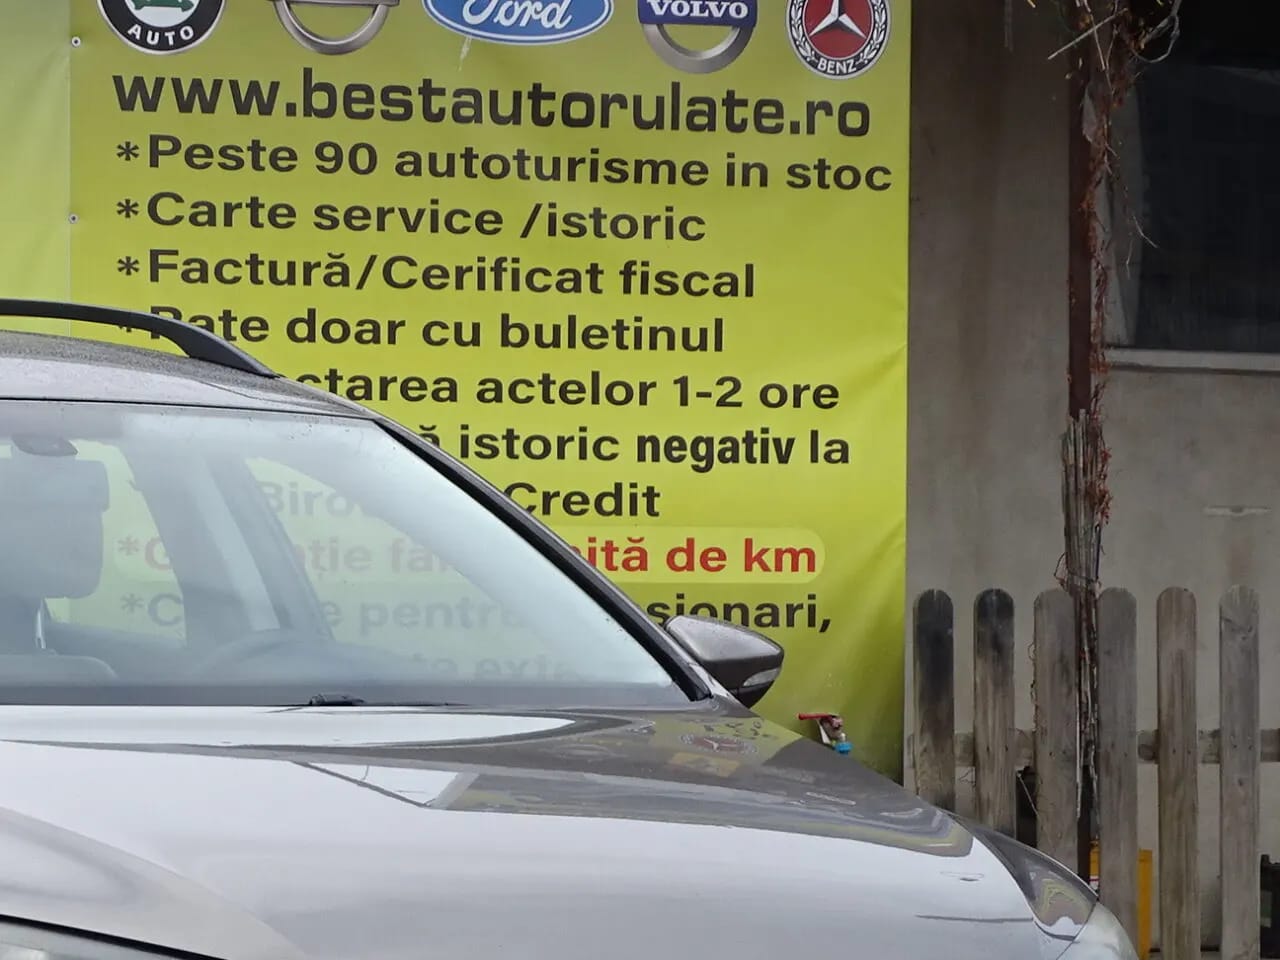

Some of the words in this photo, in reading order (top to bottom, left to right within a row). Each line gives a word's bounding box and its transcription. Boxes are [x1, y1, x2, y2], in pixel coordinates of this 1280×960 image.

[646, 0, 749, 19] VOLVO
[127, 24, 194, 46] AUTO
[817, 59, 857, 75] BENZ
[112, 67, 870, 137] www.bestautorulate.ro
[315, 141, 377, 175] 90
[395, 146, 709, 186] autoturisme
[726, 152, 768, 188] in
[786, 158, 892, 191] stoc
[313, 199, 503, 236] service
[520, 202, 706, 242] /istoric
[618, 260, 754, 298] fiscal
[286, 308, 405, 345] doar
[422, 320, 481, 347] cu
[501, 313, 723, 352] buletinul
[477, 371, 656, 407] actelor
[674, 375, 743, 408] 1-2
[759, 383, 839, 410] ore
[460, 424, 619, 461] istoric
[637, 427, 795, 474] negativ
[810, 429, 850, 464] la
[503, 482, 661, 517] Credit
[666, 537, 728, 572] de
[743, 538, 817, 573] km
